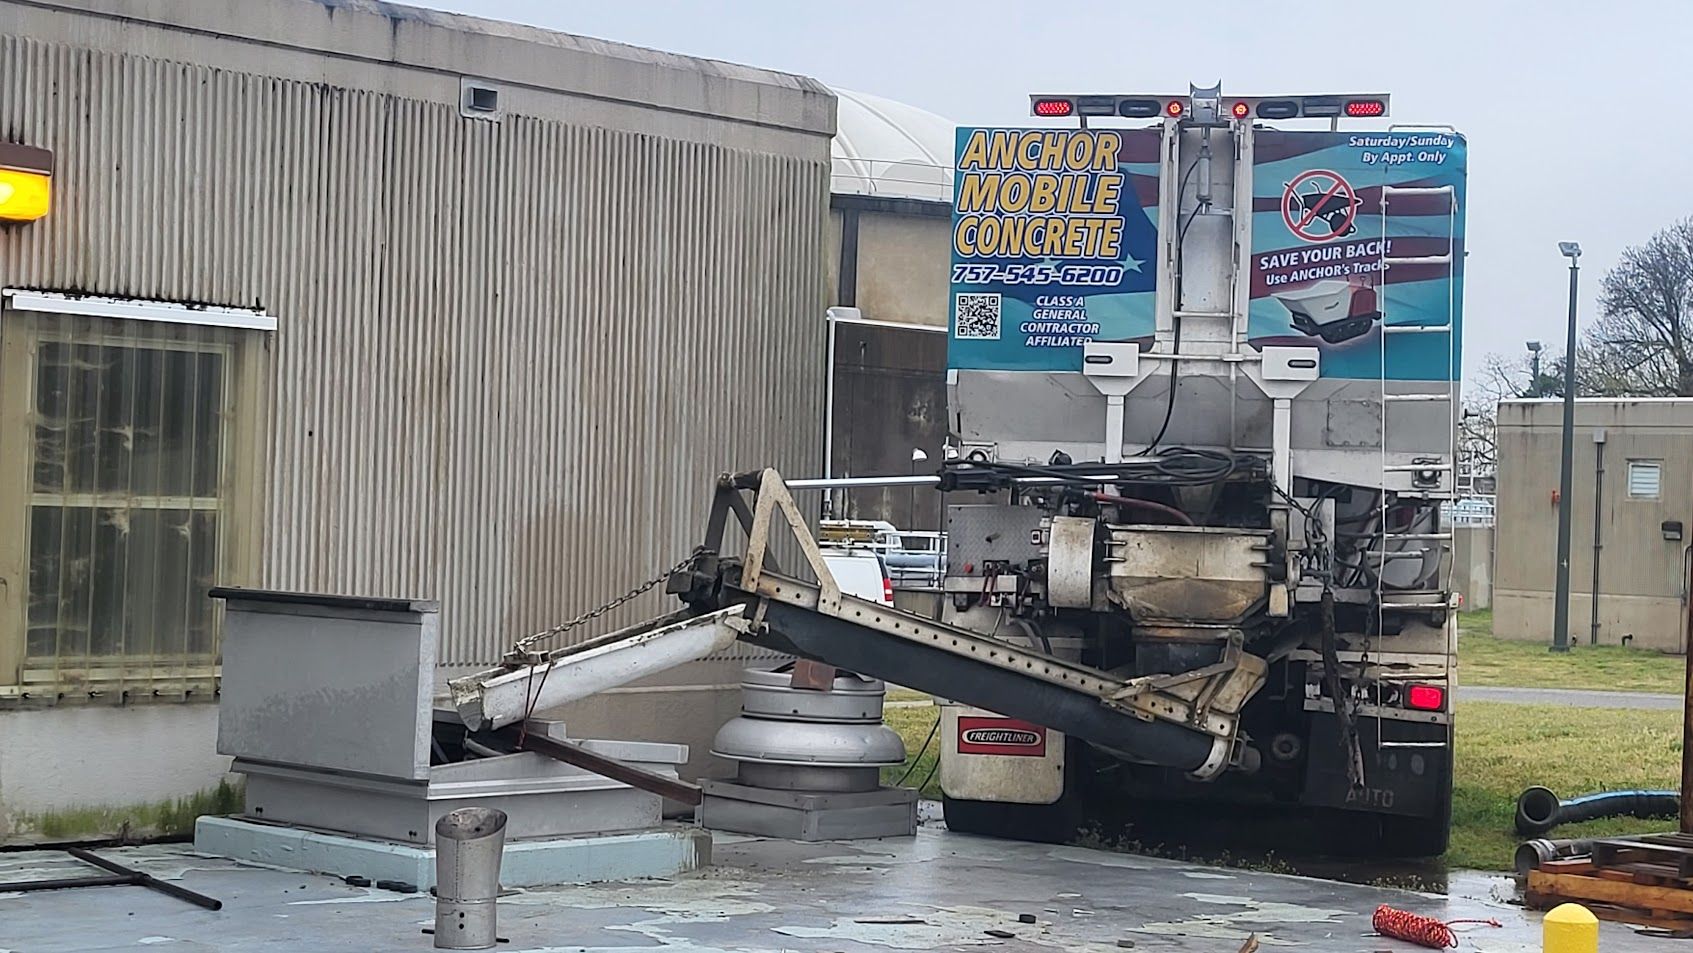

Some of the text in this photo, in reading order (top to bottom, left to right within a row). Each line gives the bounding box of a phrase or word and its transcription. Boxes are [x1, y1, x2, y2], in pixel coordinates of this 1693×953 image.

[959, 130, 1121, 171] ANCHOR
[1349, 135, 1454, 149] Saturday/Sunday
[1362, 150, 1446, 164] By Appt. Only
[957, 173, 1123, 215] MOBILE
[954, 216, 1123, 258] CONCRETE
[1260, 240, 1391, 270] SAVE YOUR BACK!
[952, 264, 1123, 286] 757-545-6200
[1266, 273, 1288, 286] Use
[1289, 263, 1351, 282] ANCHOR's
[1036, 295, 1085, 307] CLASS A
[1033, 308, 1087, 320] GENERAL
[1020, 322, 1100, 334] CONTRACTOR
[969, 731, 1034, 743] FREIGHTLINER
